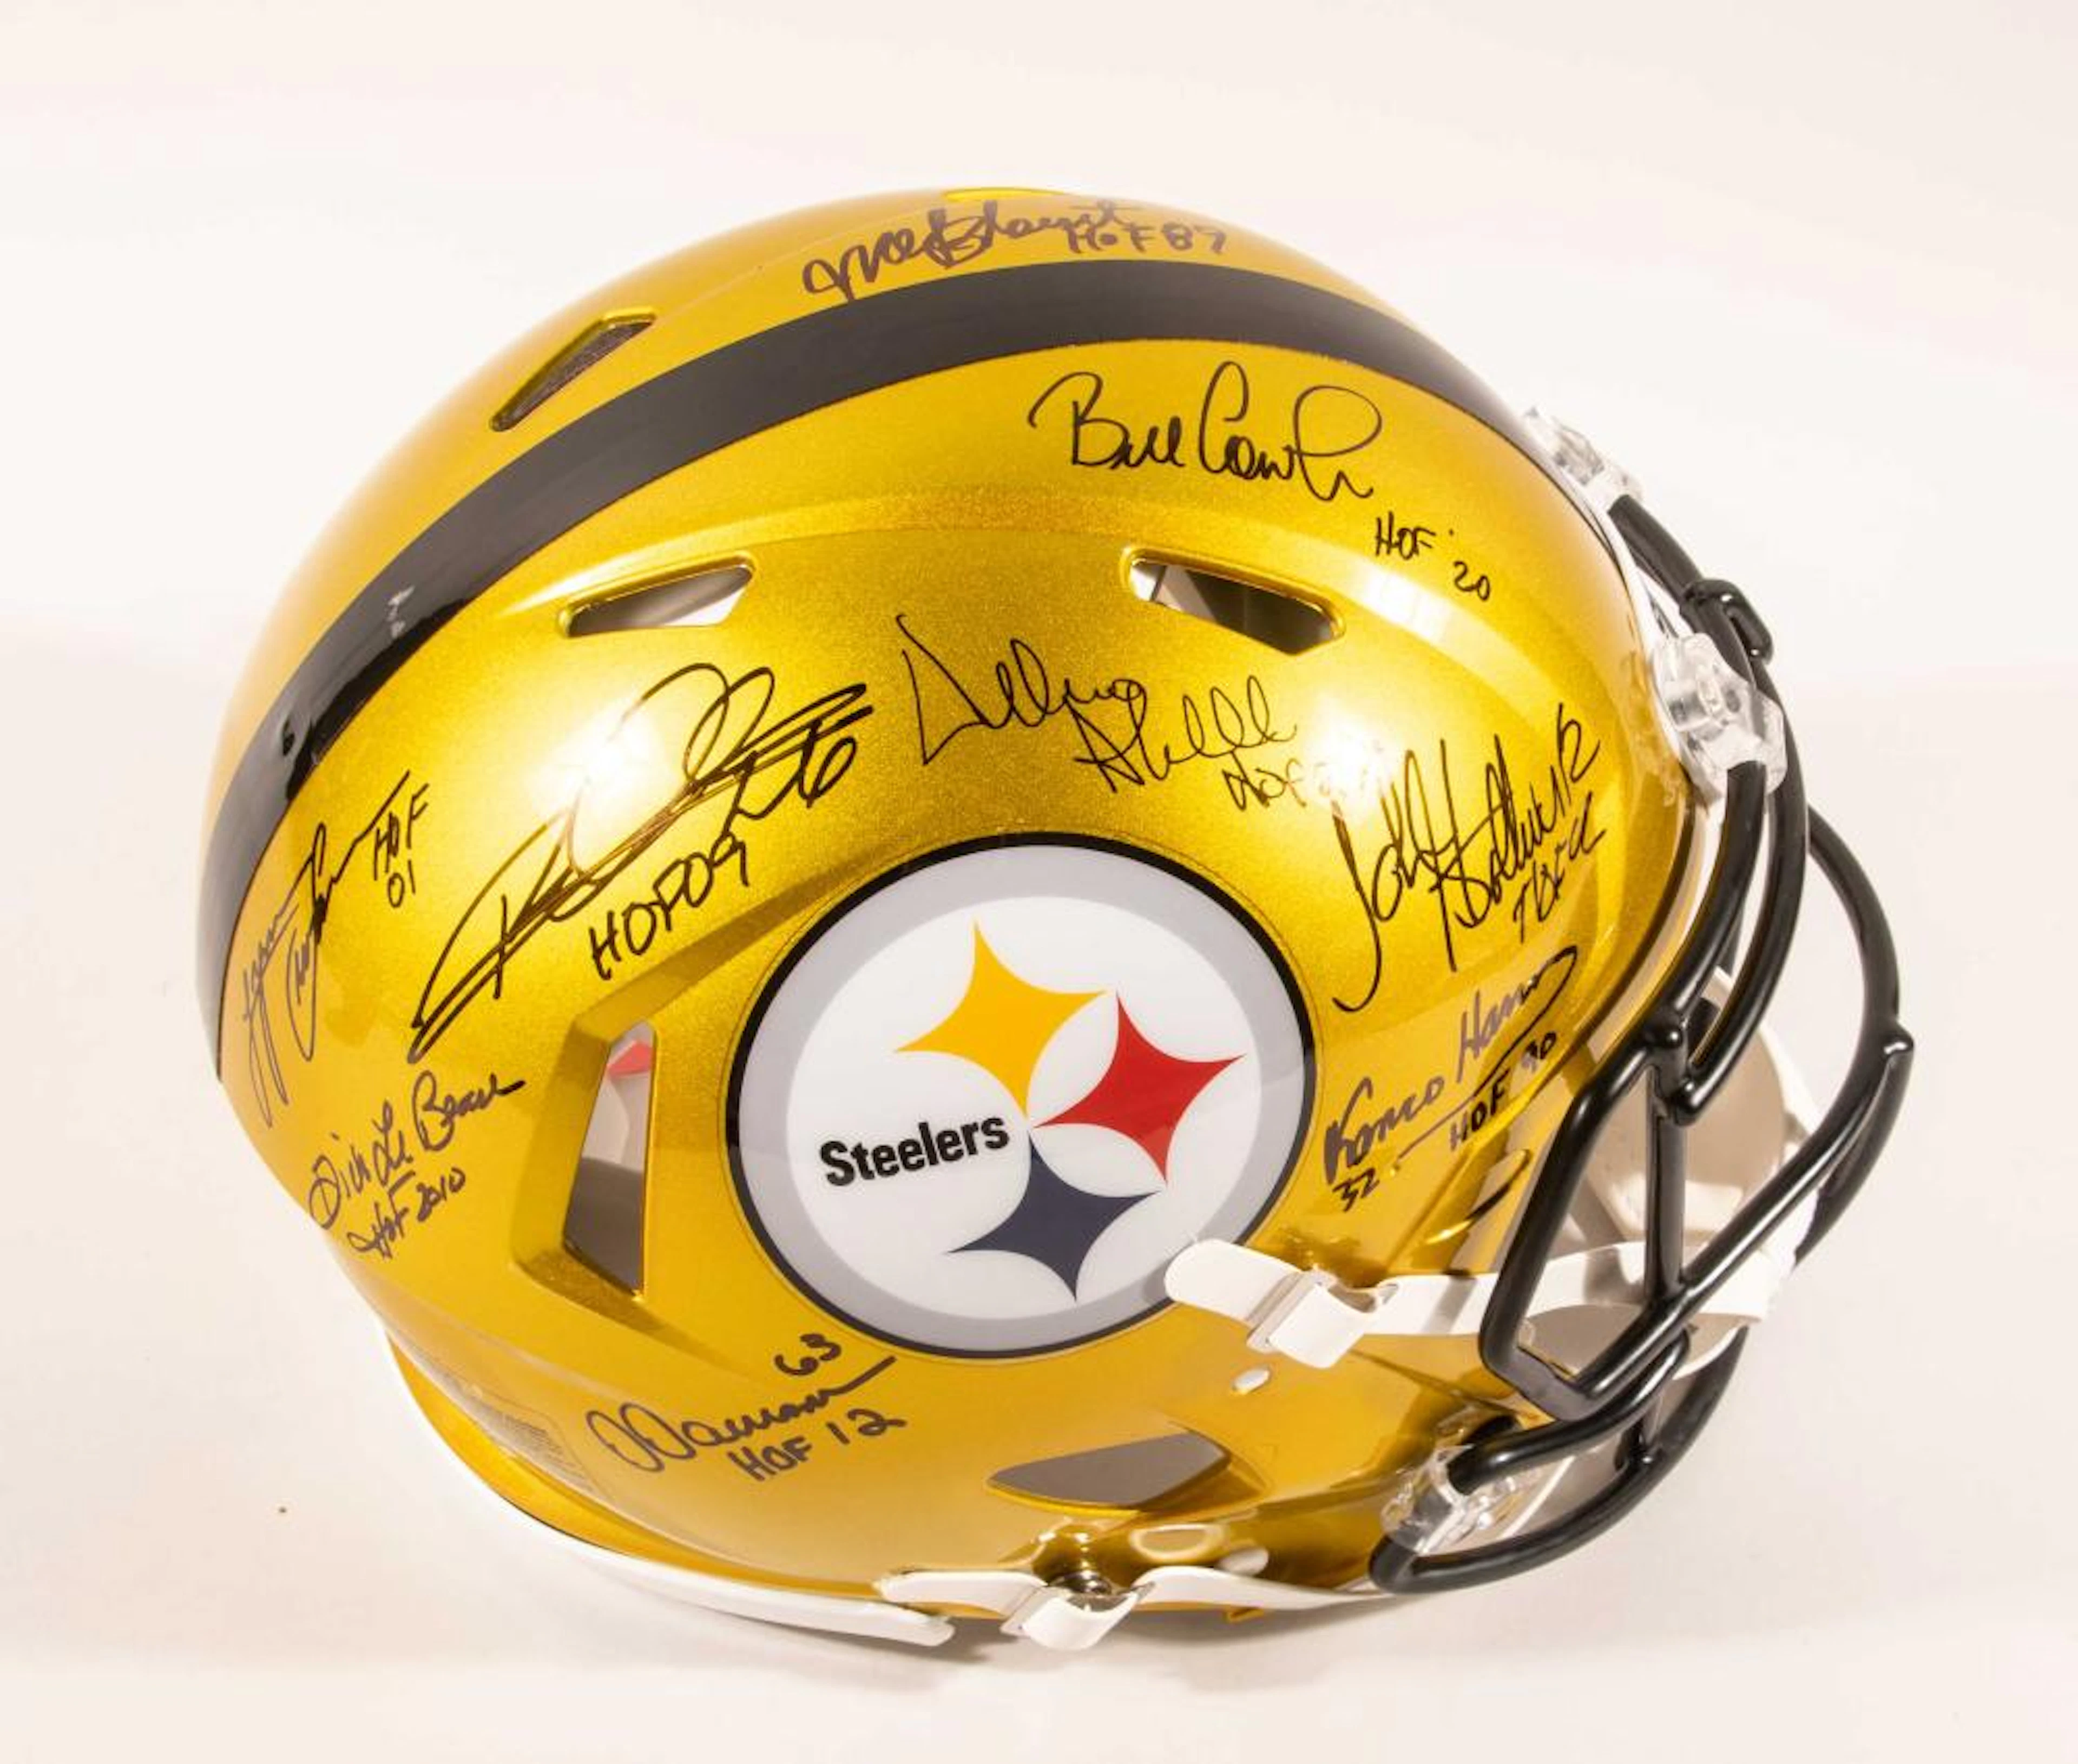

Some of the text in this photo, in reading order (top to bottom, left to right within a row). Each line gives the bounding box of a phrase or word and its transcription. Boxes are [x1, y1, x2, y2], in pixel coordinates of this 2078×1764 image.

[1374, 511, 1437, 561] HOF
[819, 1116, 1010, 1186] Steelers
[727, 1434, 813, 1482] HOF
